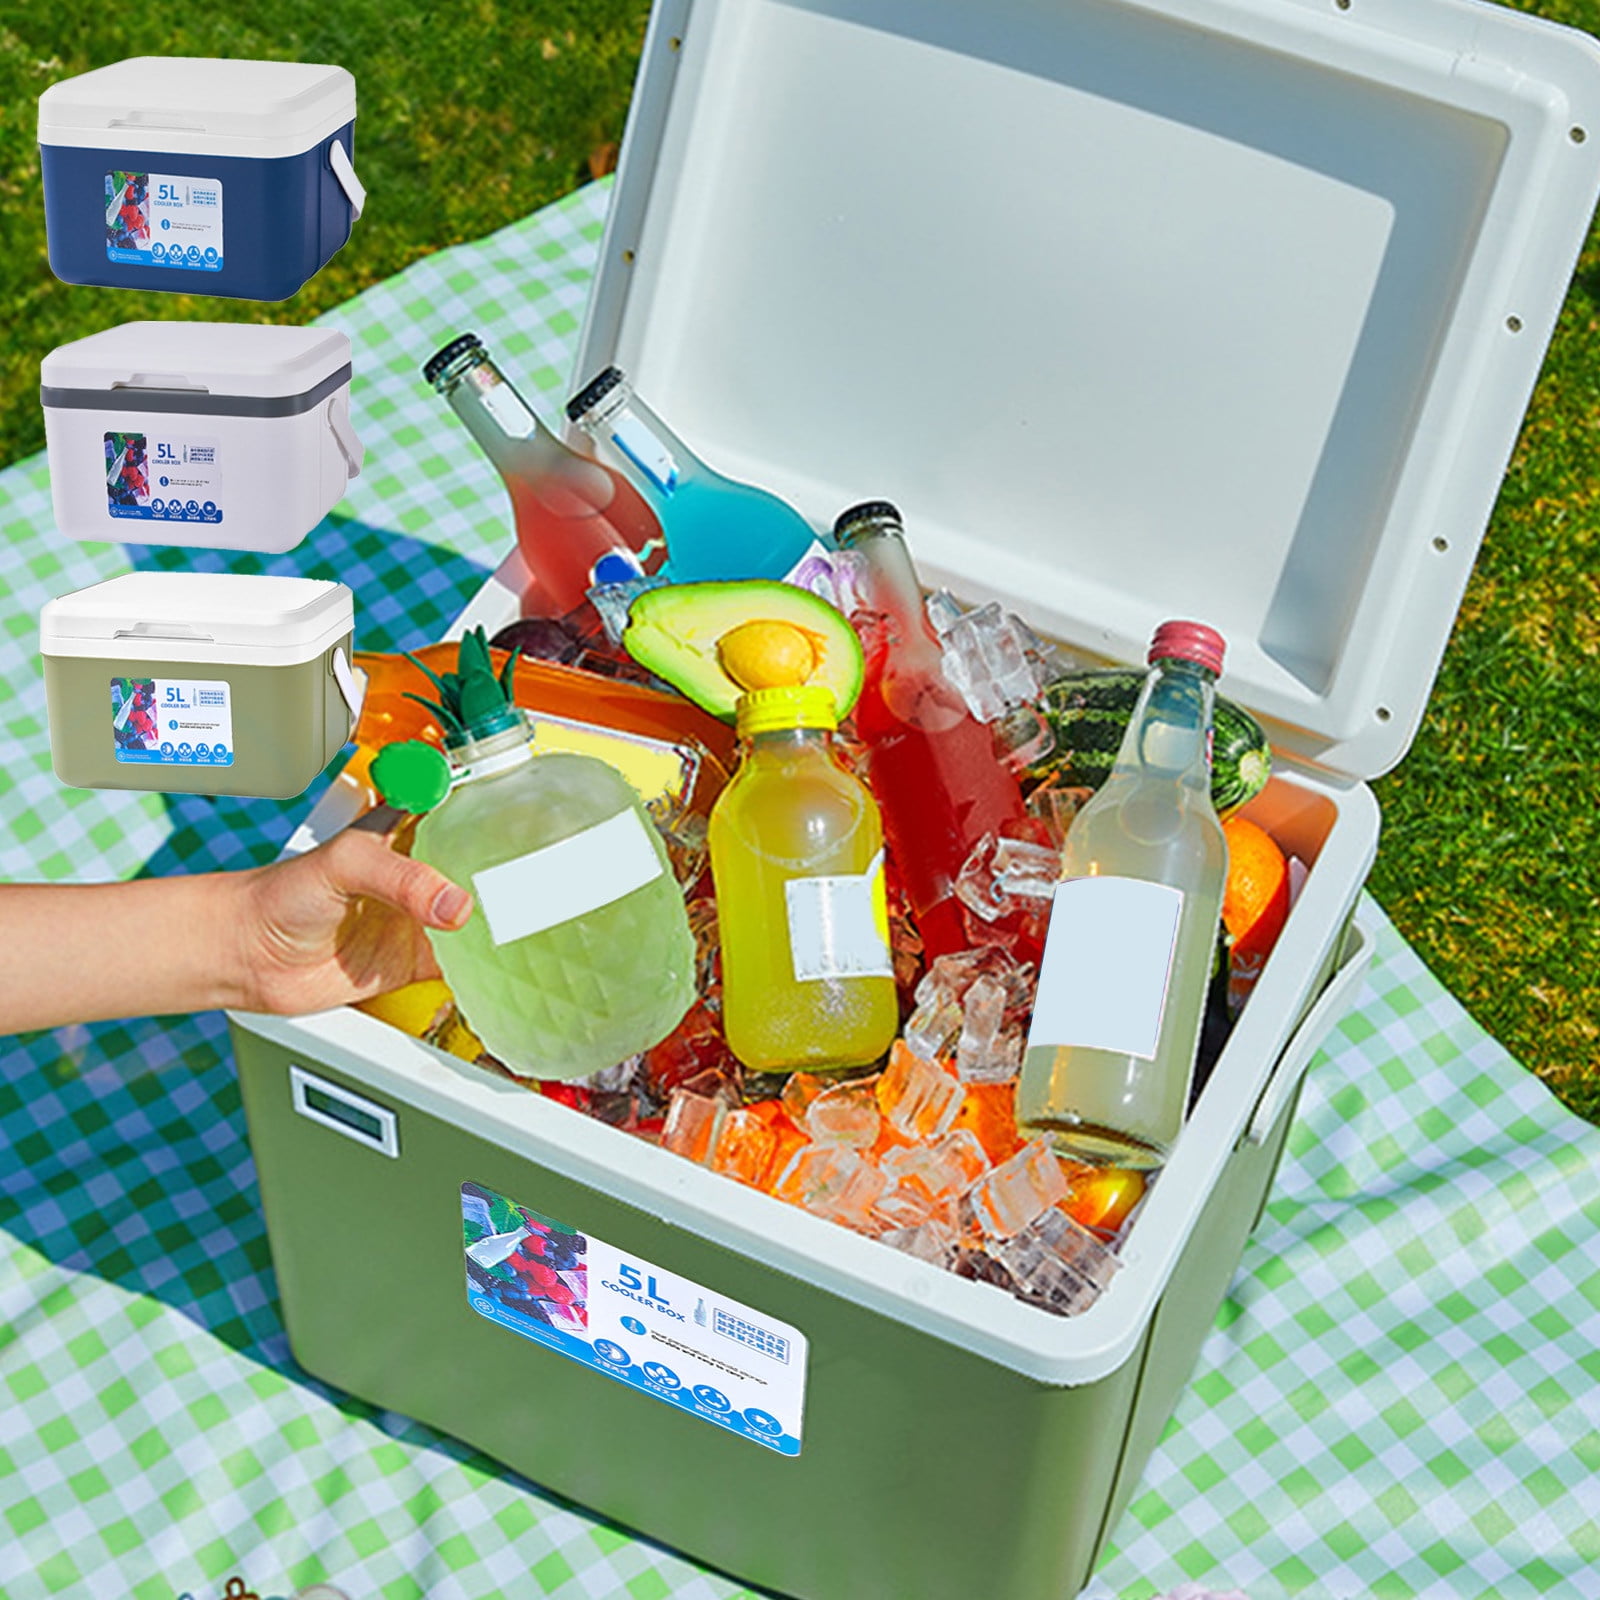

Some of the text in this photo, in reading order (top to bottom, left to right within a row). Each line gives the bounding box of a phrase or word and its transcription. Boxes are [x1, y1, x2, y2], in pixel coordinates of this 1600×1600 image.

[158, 184, 180, 201] 5L
[157, 443, 176, 459] 5L
[166, 687, 185, 702] 5L
[618, 1263, 670, 1306] 5L
[601, 1279, 685, 1323] COOLER BOX
